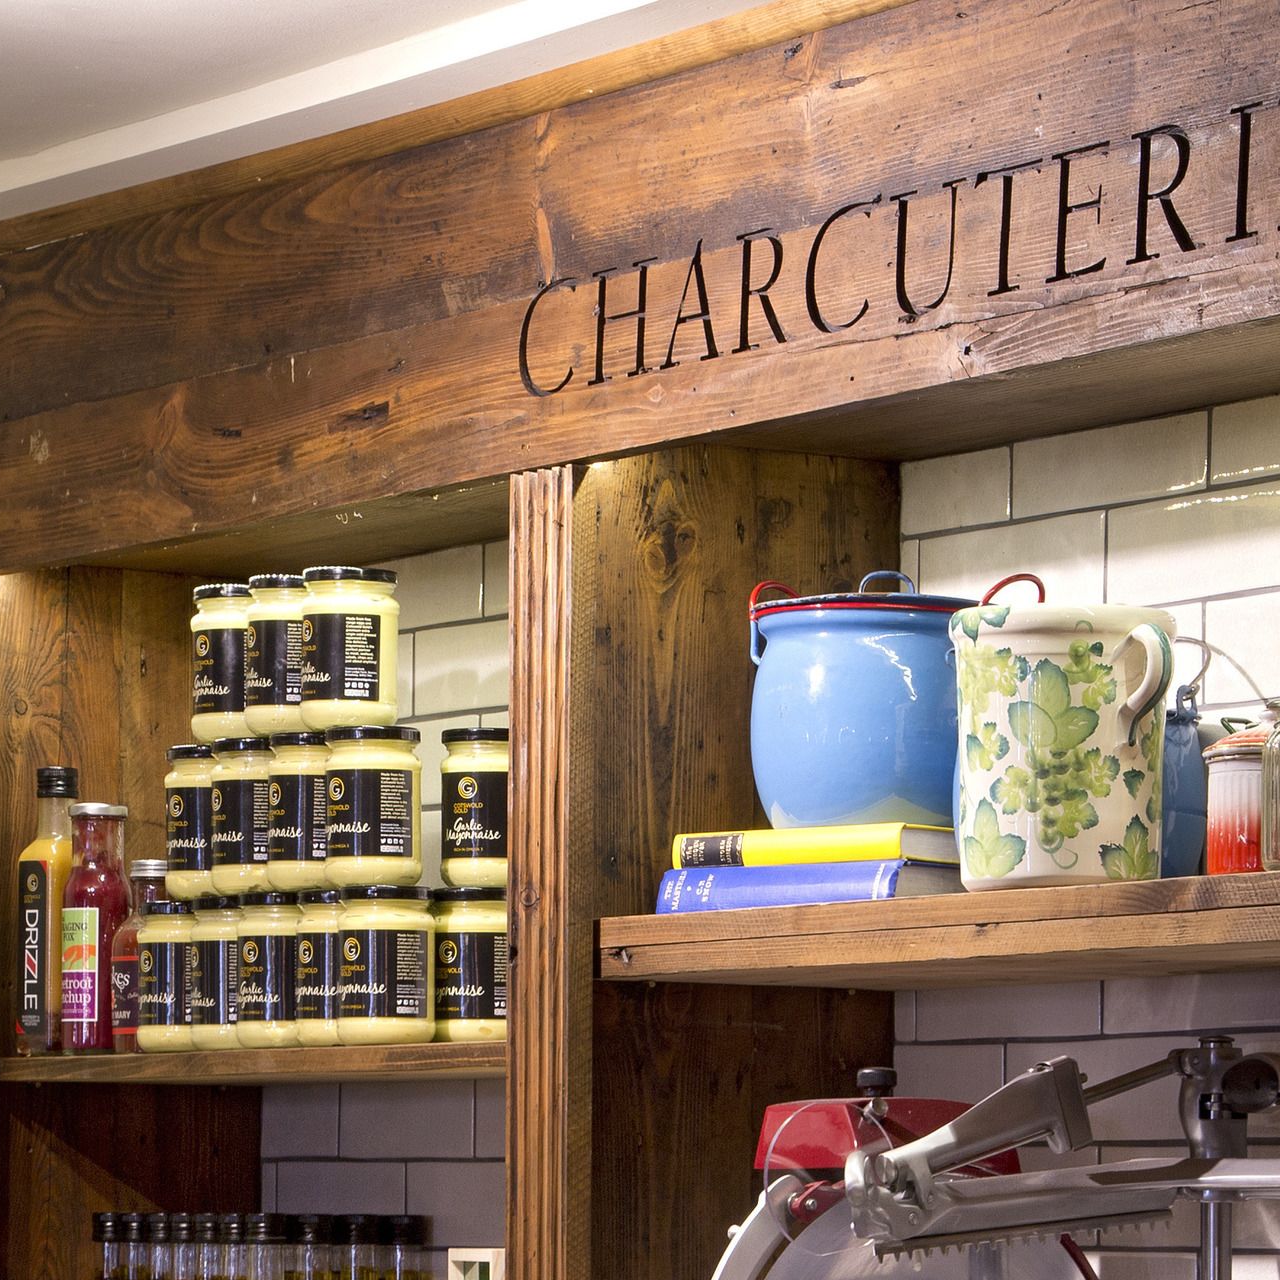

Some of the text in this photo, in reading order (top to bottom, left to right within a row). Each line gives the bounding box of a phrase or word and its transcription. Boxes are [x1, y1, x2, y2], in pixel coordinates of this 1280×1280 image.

[453, 817, 483, 832] Garlic
[24, 909, 39, 1010] DRIZZLE
[240, 980, 263, 995] Garlic
